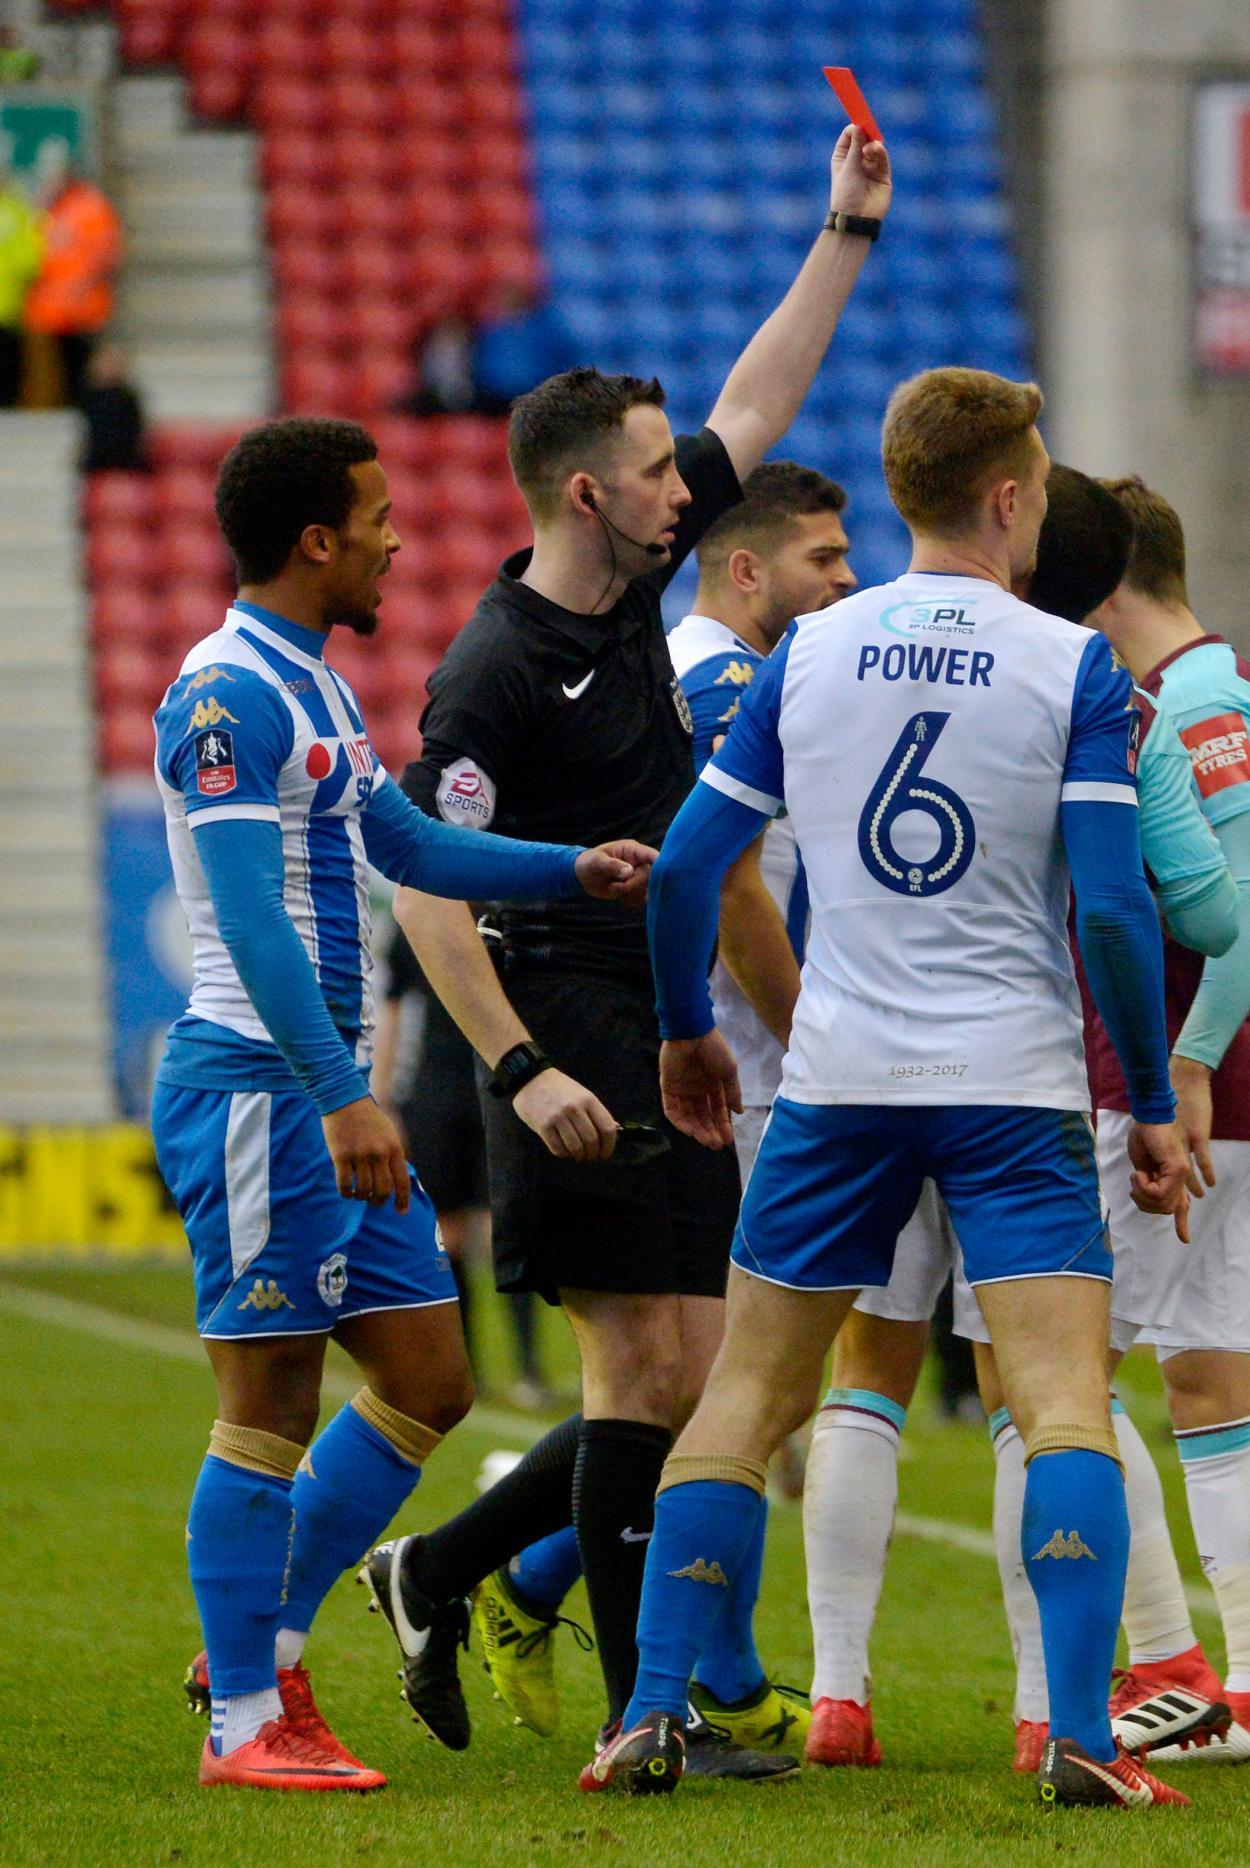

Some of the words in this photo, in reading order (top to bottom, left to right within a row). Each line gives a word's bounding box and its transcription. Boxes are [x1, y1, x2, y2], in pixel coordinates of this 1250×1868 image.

[909, 608, 976, 626] 3PL
[922, 625, 975, 635] LOGISTICS
[857, 643, 995, 688] POWER
[1190, 731, 1248, 766] MRF
[1198, 748, 1248, 776] TYRES
[445, 793, 490, 819] SPORTS
[857, 711, 976, 897] 6
[909, 884, 922, 892] EFL
[888, 1064, 969, 1079] 1932-2017
[484, 1596, 498, 1658] adidas
